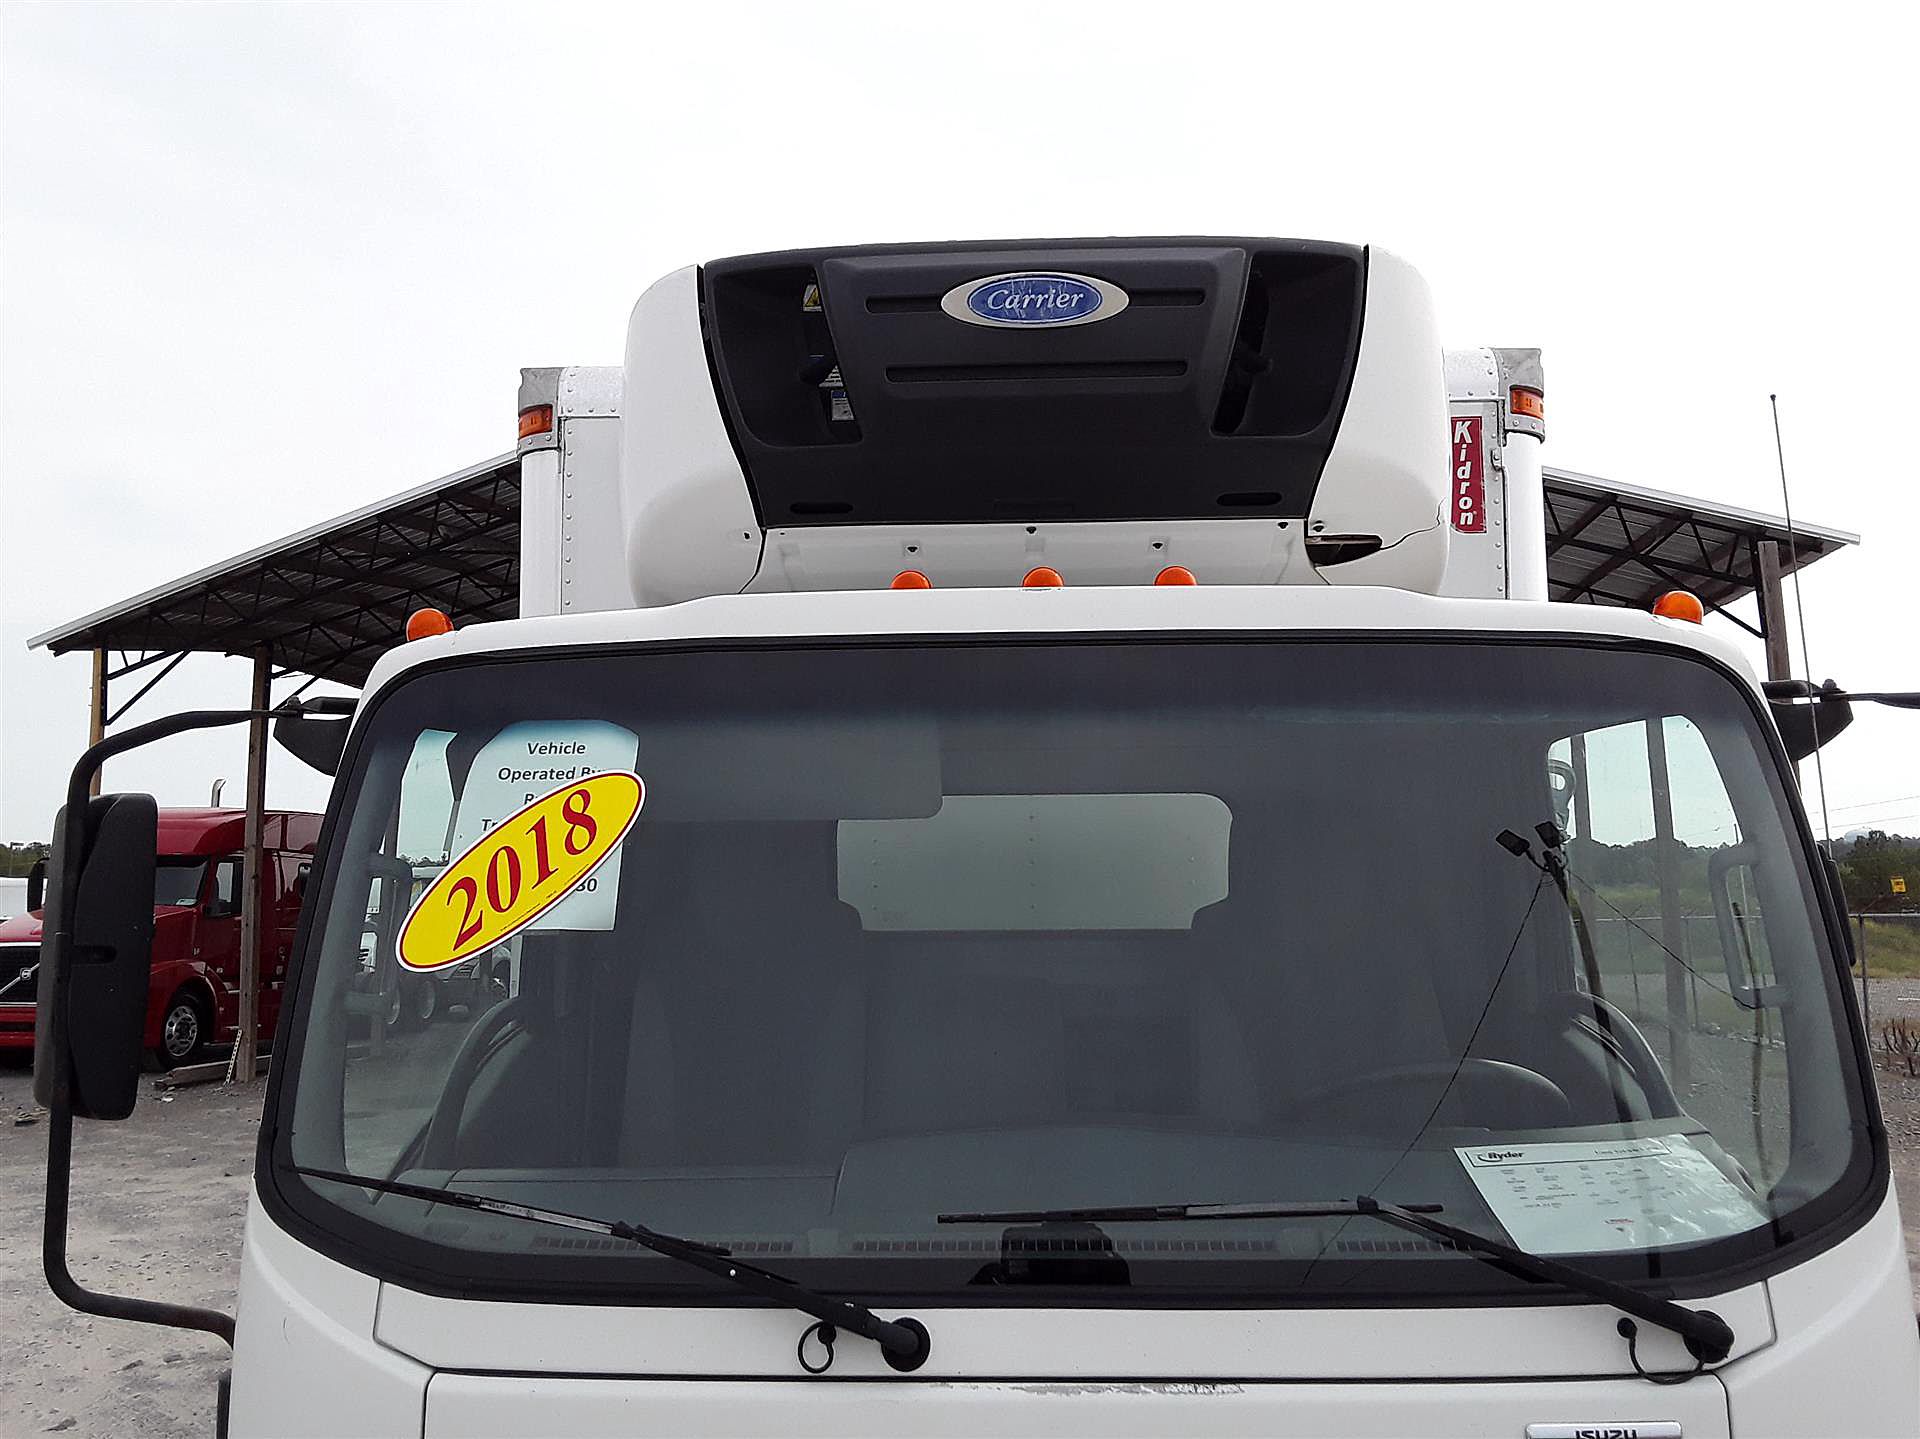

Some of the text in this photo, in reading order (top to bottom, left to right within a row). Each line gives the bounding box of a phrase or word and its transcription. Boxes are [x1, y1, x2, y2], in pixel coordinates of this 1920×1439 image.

[986, 289, 1084, 310] Carrier
[1453, 420, 1473, 525] Kidron
[527, 741, 586, 755] Vehicle
[498, 766, 576, 784] Operated
[446, 788, 598, 952] 2018
[1487, 1151, 1525, 1161] Ryder
